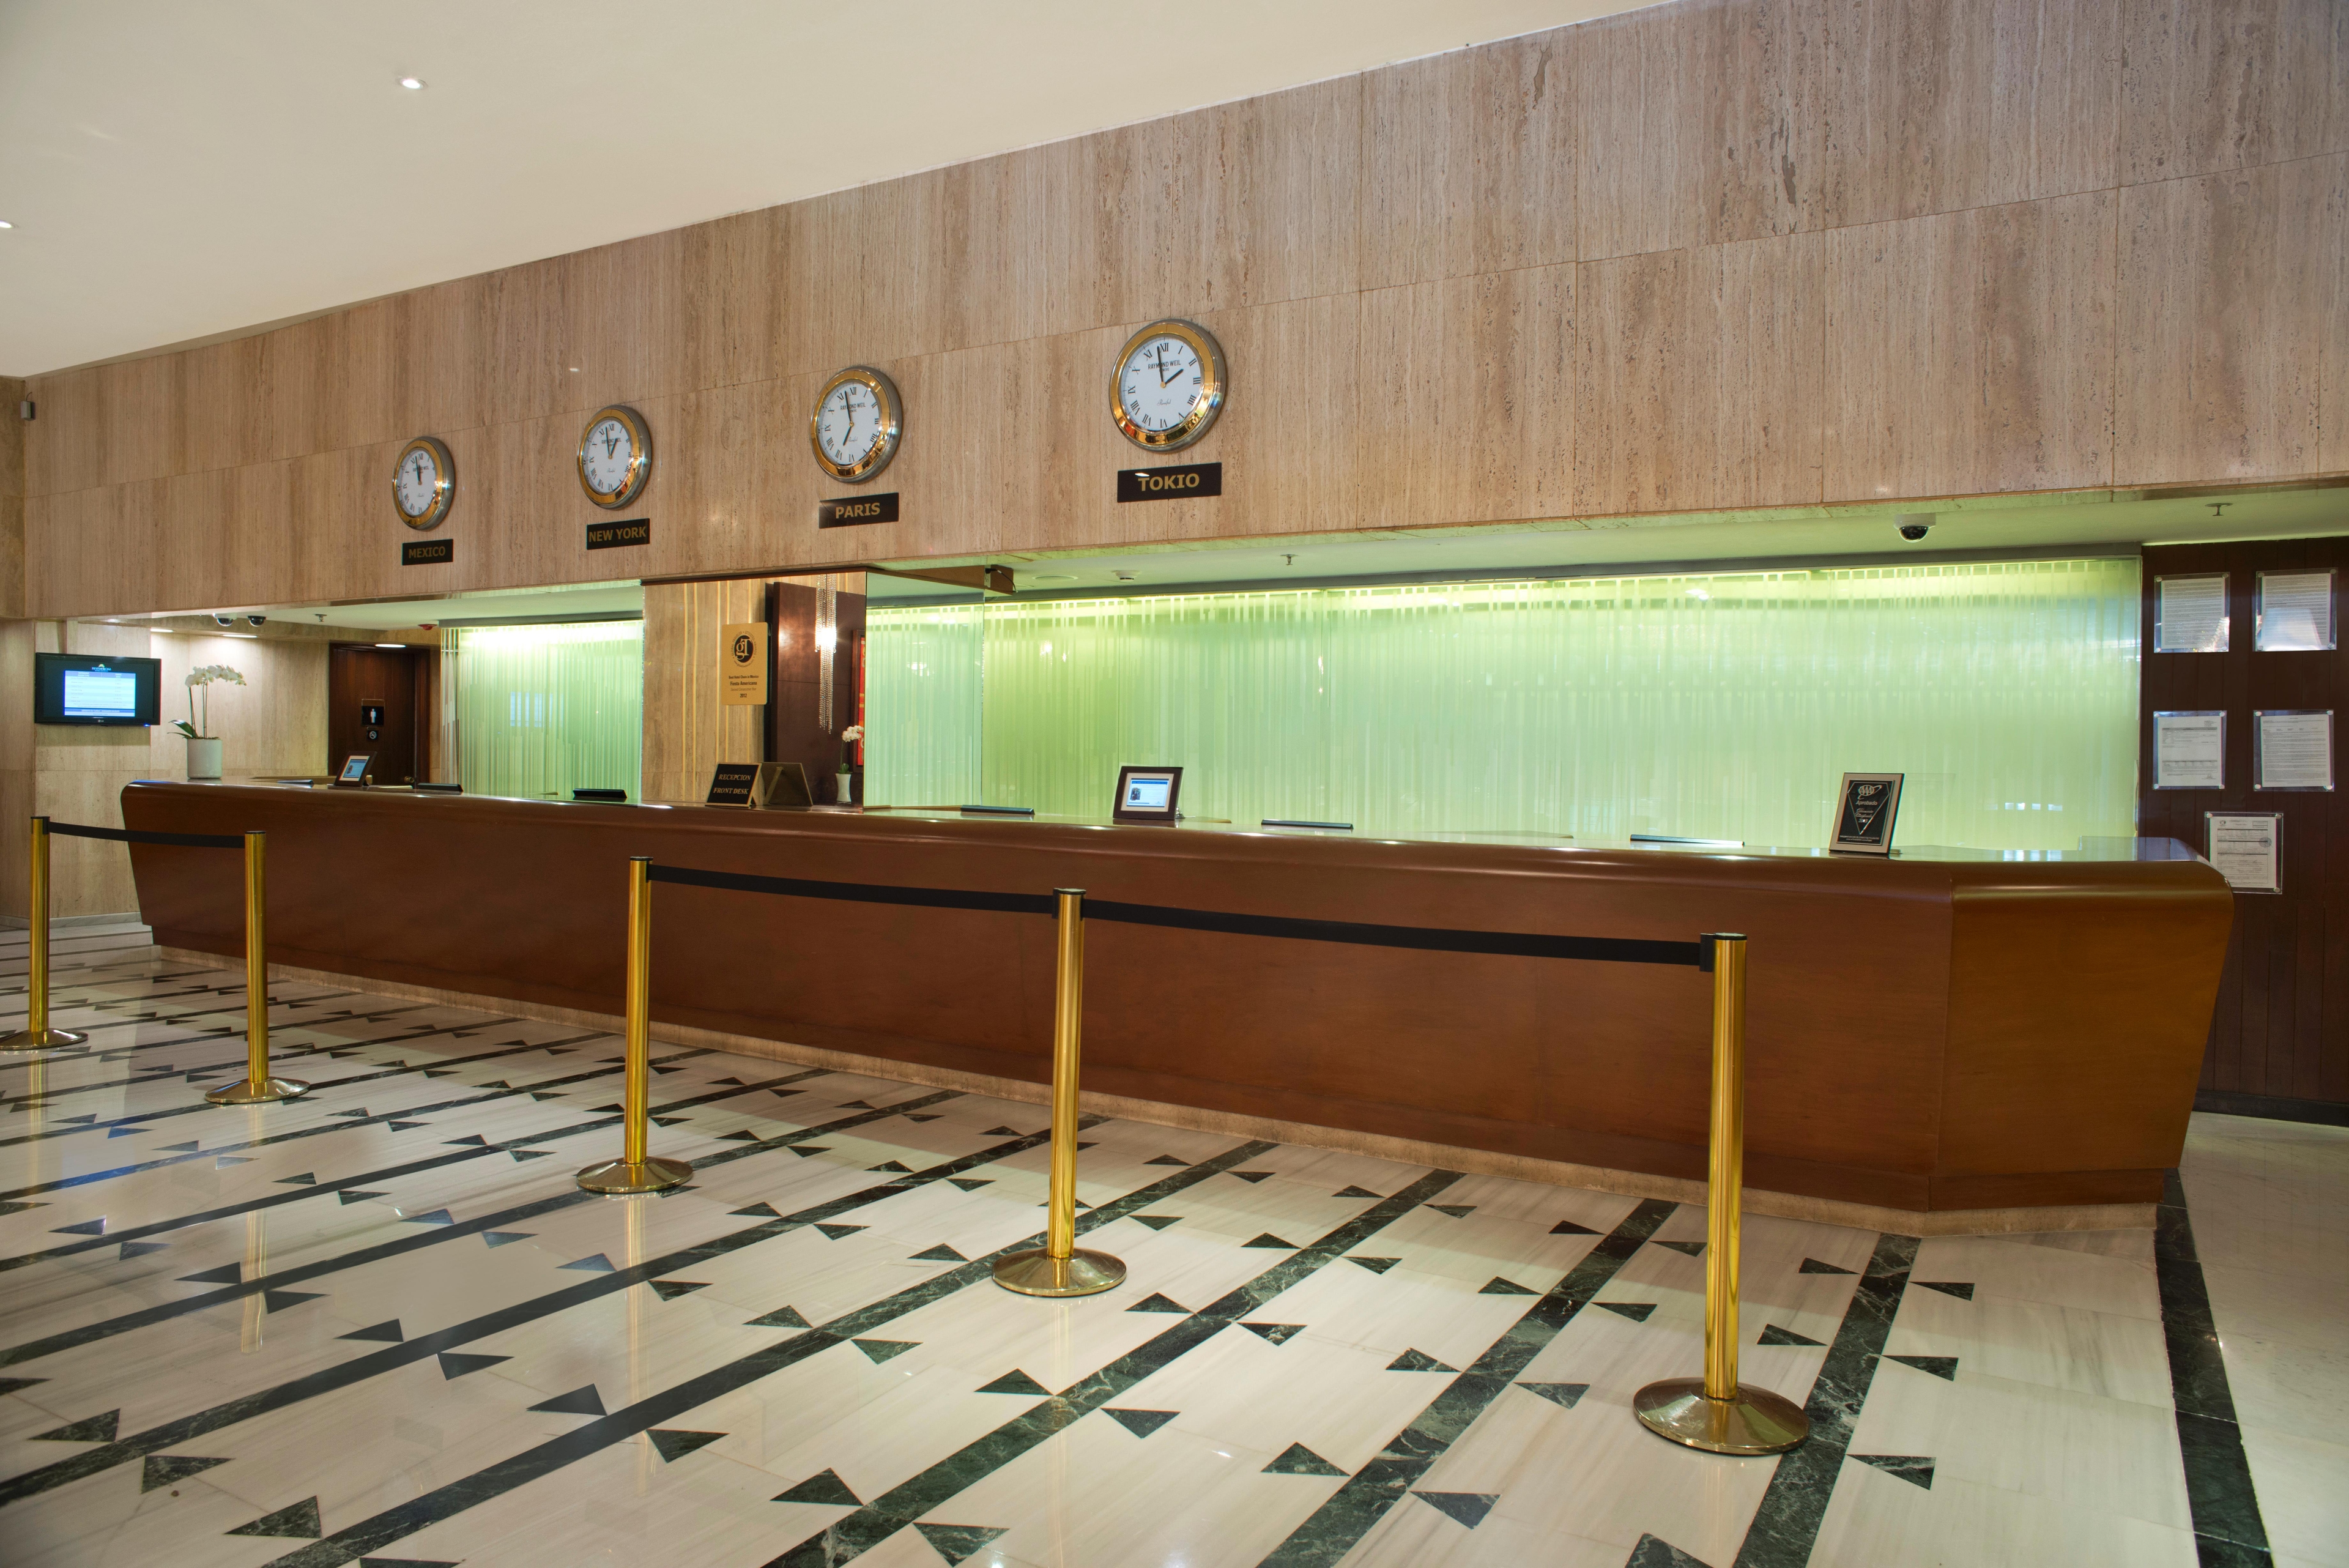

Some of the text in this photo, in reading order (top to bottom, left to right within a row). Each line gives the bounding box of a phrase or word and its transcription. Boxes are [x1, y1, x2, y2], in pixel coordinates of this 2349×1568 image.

[1160, 343, 1169, 352] XII
[1178, 346, 1183, 355] I
[1143, 349, 1152, 361] XI
[1189, 358, 1197, 366] II
[1132, 366, 1140, 374] X
[1128, 385, 1136, 394] IX
[1187, 394, 1197, 406] IIII
[1130, 400, 1140, 415] VIII
[1142, 414, 1151, 426] VII
[1160, 419, 1168, 428] VI
[1138, 474, 1200, 491] TOKIO
[836, 502, 880, 519] PARIS
[588, 526, 647, 542] NEW YORK
[409, 546, 445, 559] MEXICO
